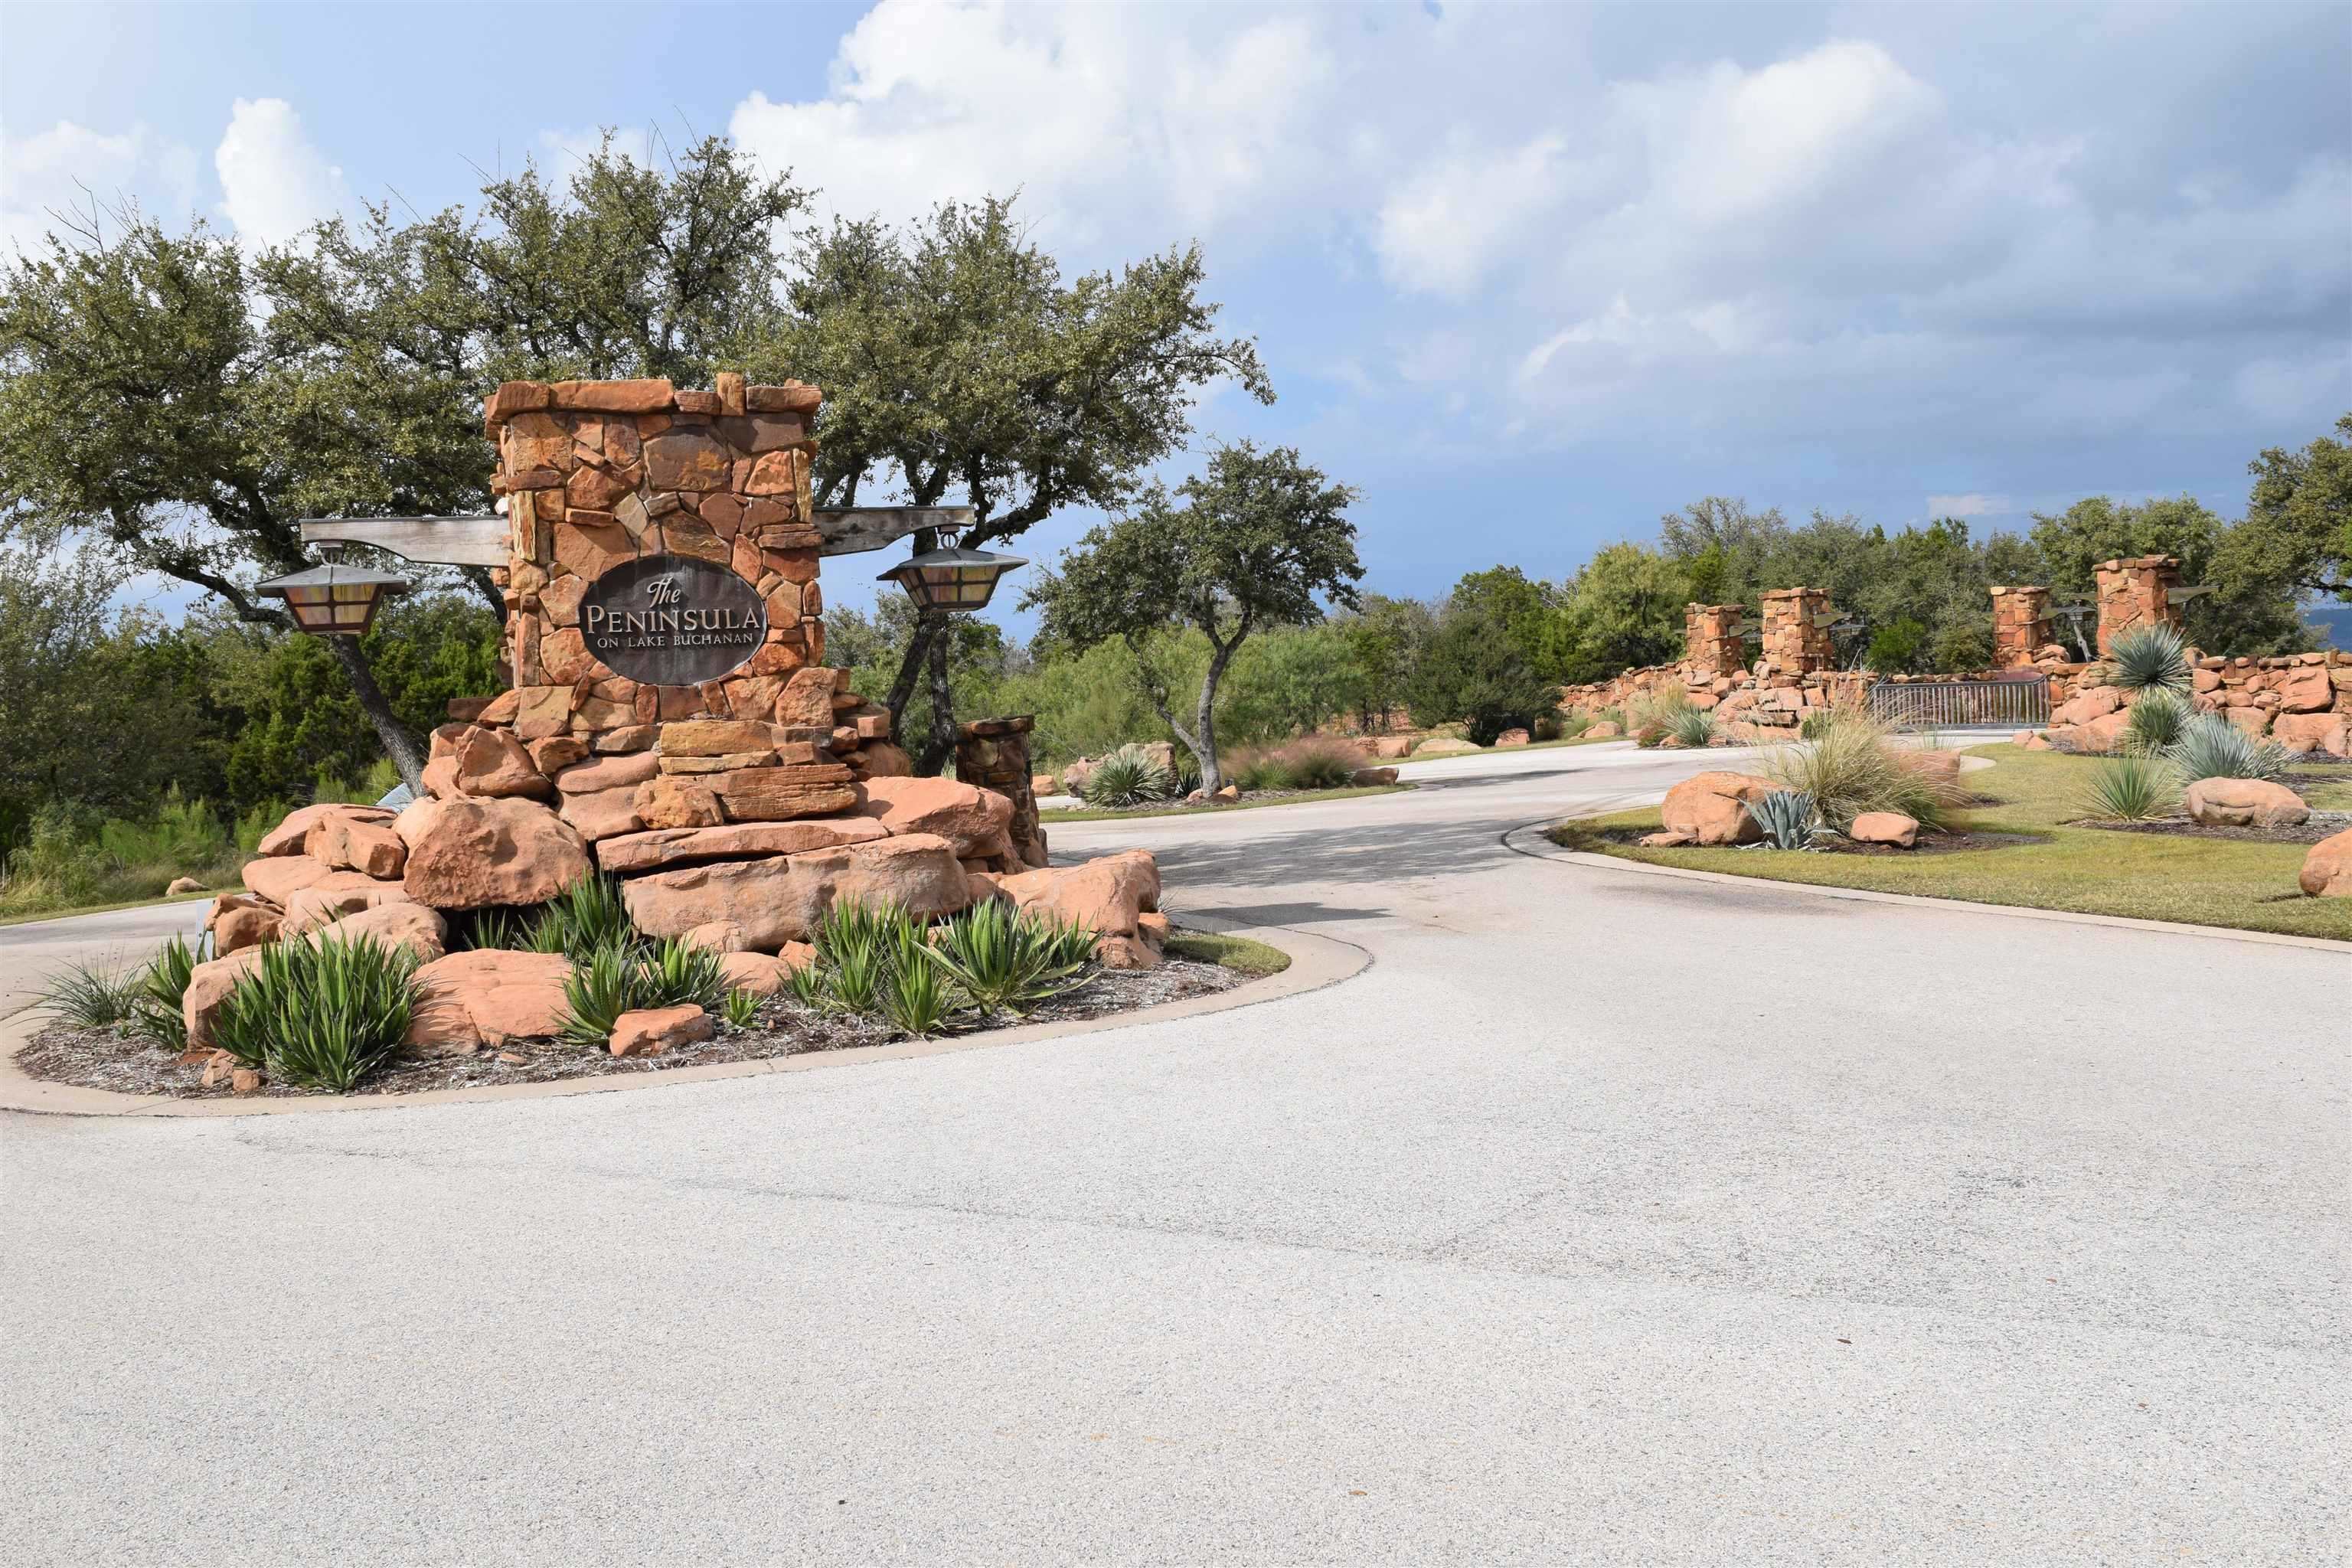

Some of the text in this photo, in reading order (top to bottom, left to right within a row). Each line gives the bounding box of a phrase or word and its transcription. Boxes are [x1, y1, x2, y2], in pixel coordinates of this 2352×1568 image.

[647, 577, 681, 607] The
[586, 605, 760, 634] PENINSULA
[597, 632, 753, 648] ON LAKE BUCHANAN
